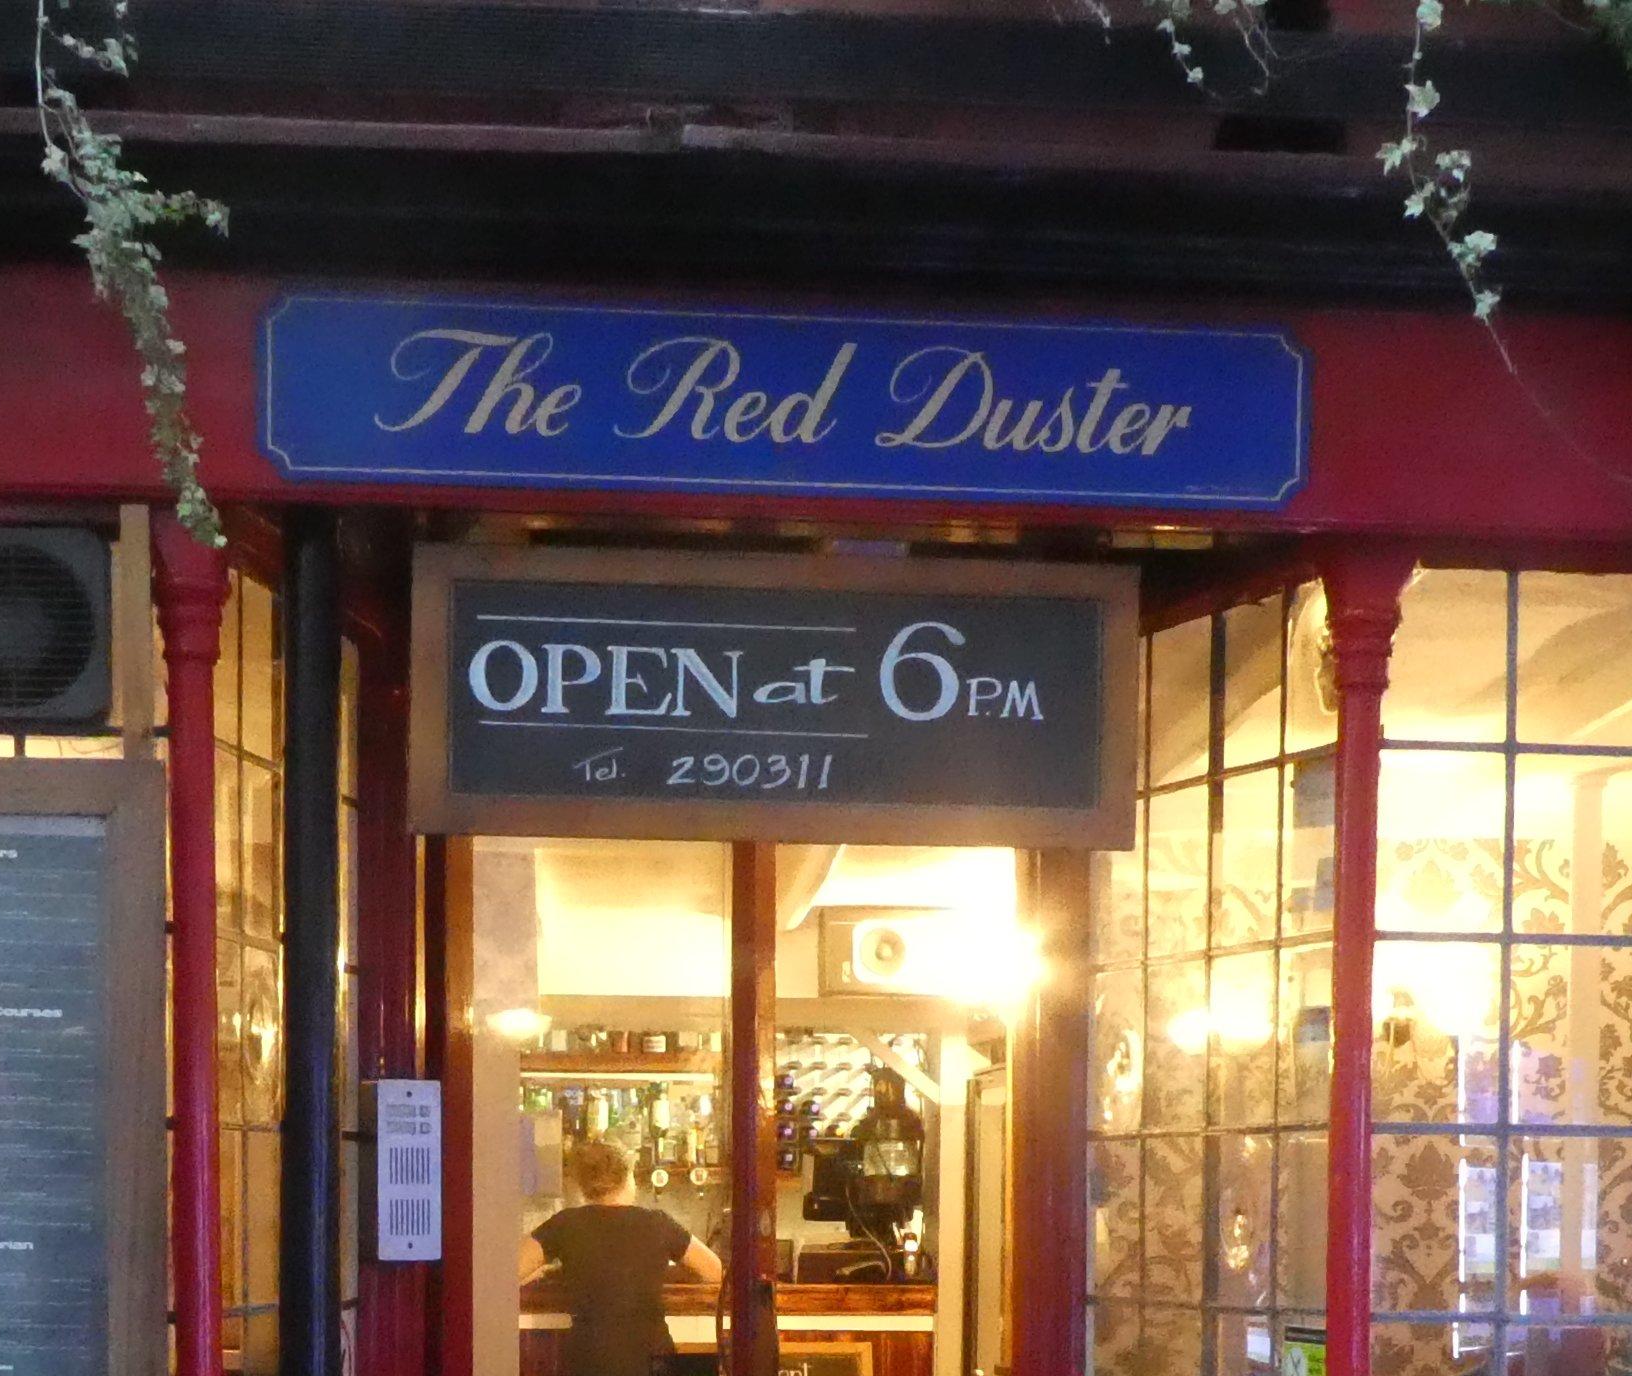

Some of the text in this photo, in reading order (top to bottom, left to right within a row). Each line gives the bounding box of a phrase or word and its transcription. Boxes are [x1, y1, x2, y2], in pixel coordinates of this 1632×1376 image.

[374, 327, 1192, 458] The Red Duster
[468, 637, 744, 719] OPEN
[751, 656, 857, 710] at
[666, 753, 833, 790] 290311
